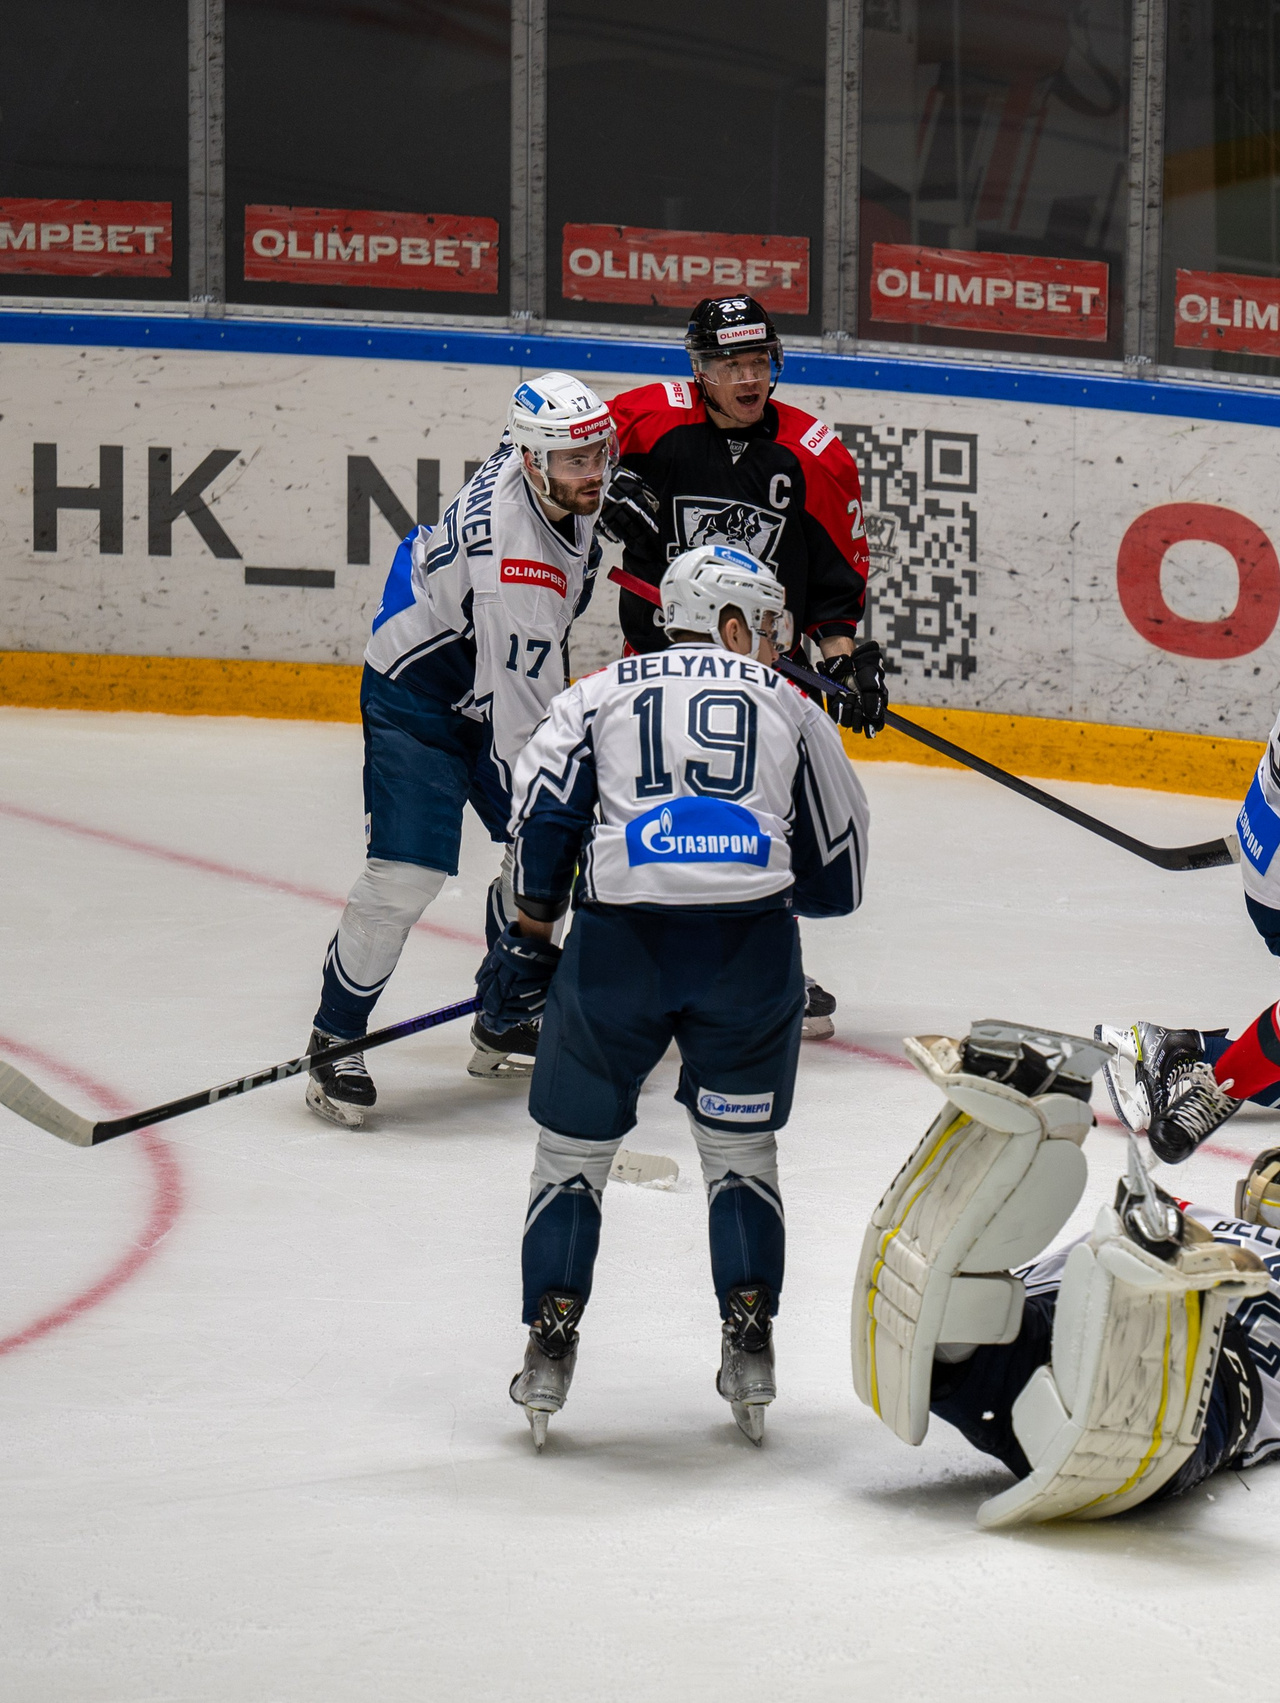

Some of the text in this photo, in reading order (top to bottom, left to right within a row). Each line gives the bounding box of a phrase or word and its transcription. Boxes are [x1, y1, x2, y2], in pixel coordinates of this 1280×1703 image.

[252, 228, 490, 269] OLIMPBET
[568, 246, 801, 290] OLIMPBET
[719, 300, 748, 313] 29
[877, 268, 1101, 315] OLIMPBET
[720, 327, 765, 340] OLIMPBET
[461, 442, 515, 557] NECHAYEV
[768, 473, 792, 510] C
[847, 498, 866, 541] 2
[503, 565, 567, 592] OLIMPBET
[506, 633, 552, 679] 17
[617, 655, 780, 690] BELYAYEV
[632, 685, 758, 803] 19
[677, 835, 758, 855] ГАЗПРОМ
[1239, 804, 1264, 861] АЗПРОМ
[209, 1055, 312, 1105] CCM
[725, 1102, 770, 1114] БУРЭНЕРГО
